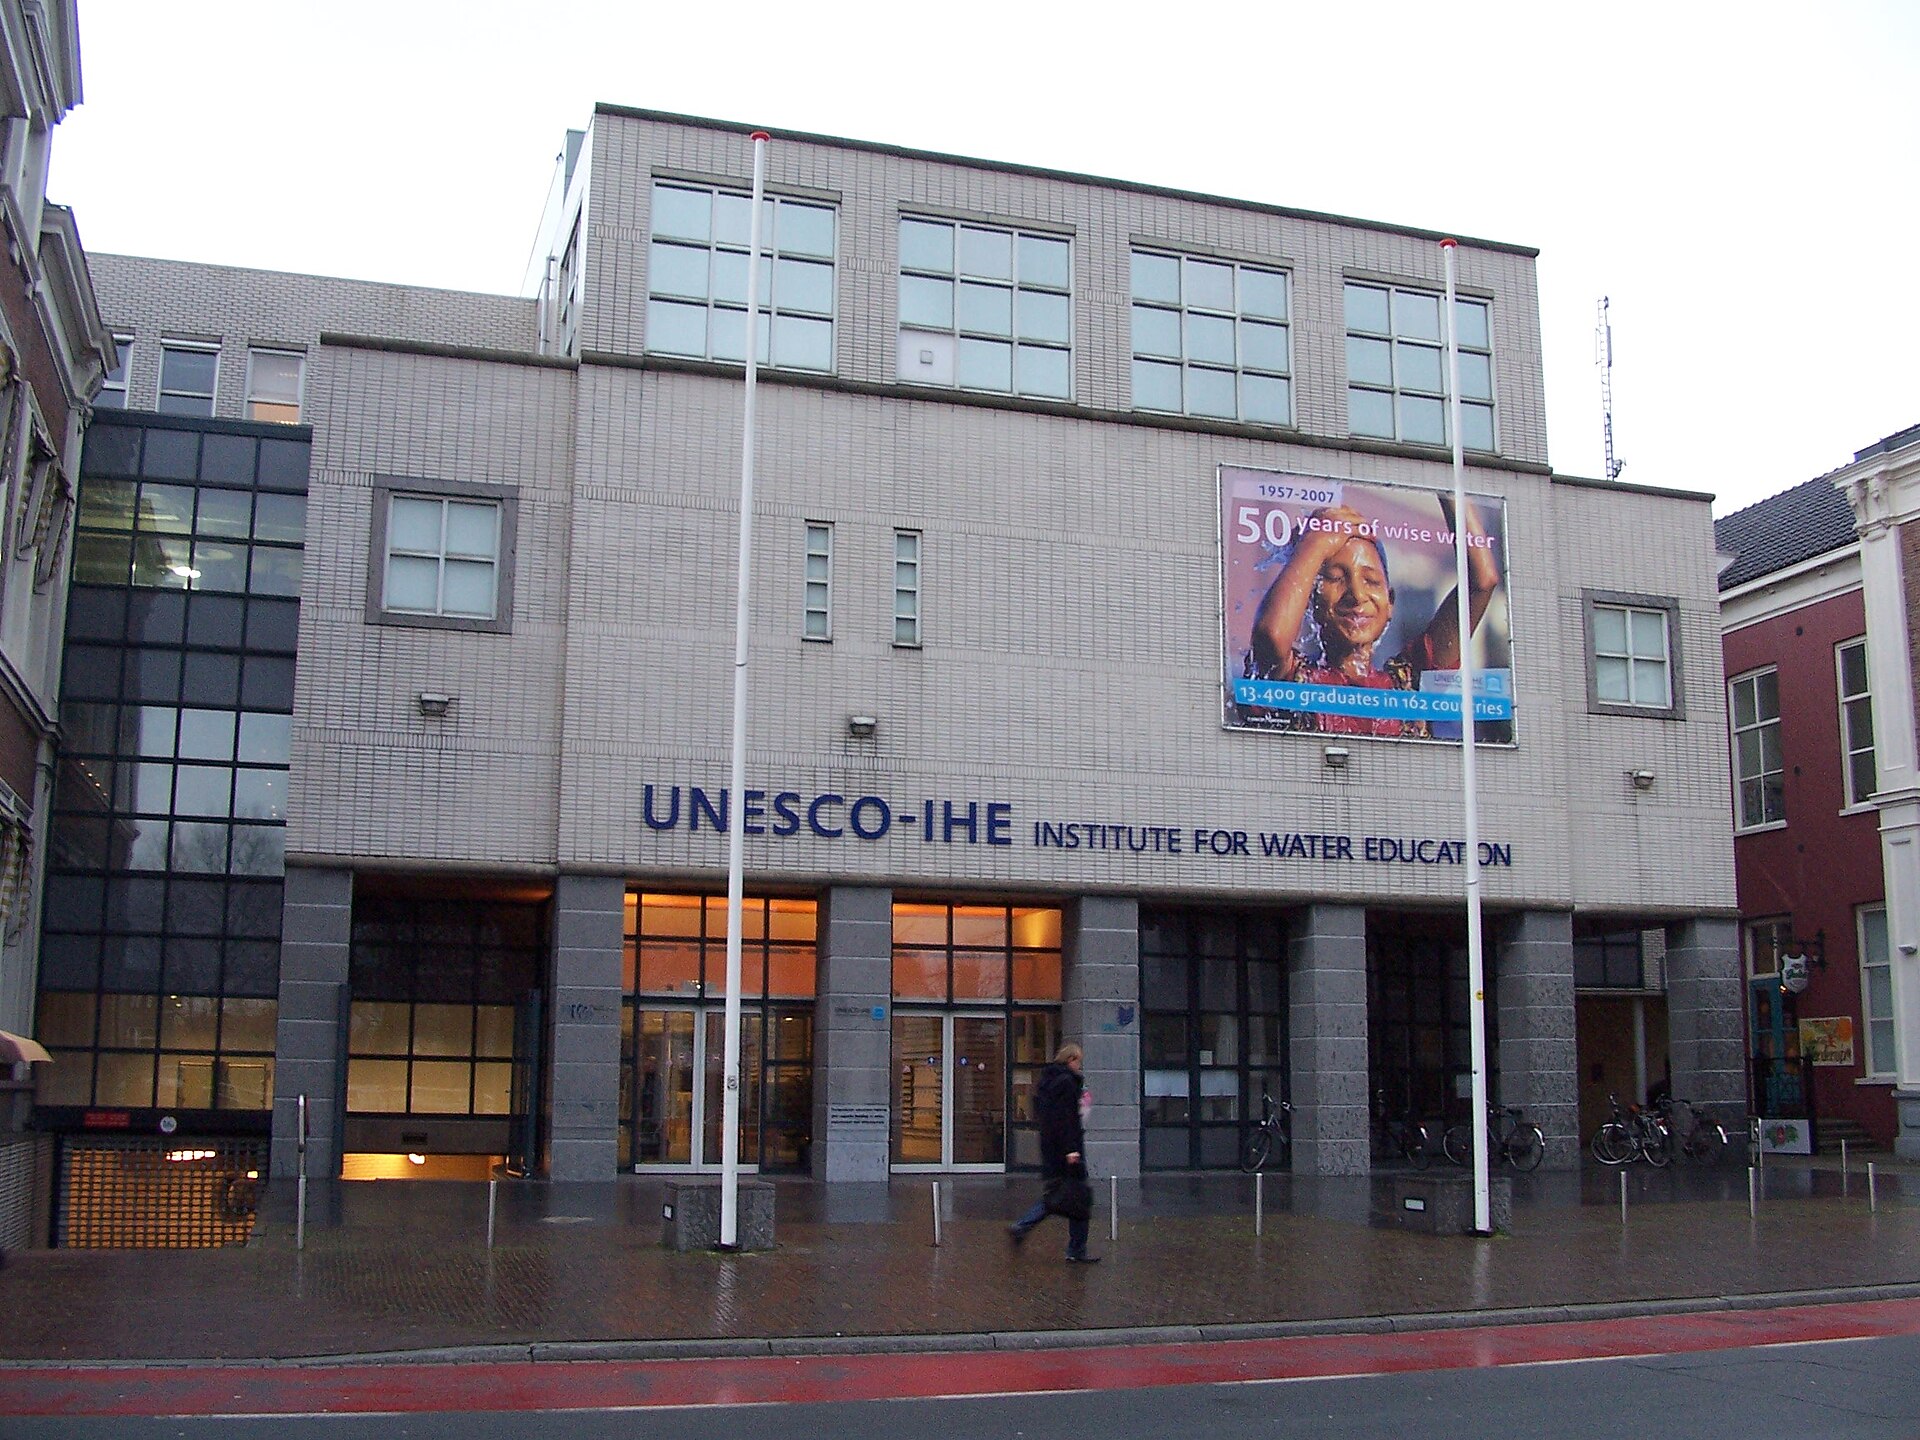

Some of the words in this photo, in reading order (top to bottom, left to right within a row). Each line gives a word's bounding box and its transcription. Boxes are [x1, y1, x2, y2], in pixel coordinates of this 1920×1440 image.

[1259, 485, 1334, 503] 1957-2007
[1237, 506, 1292, 547] 50
[1296, 515, 1353, 536] years
[1358, 518, 1379, 536] of
[1384, 522, 1431, 541] wise
[1436, 531, 1495, 549] wter
[1240, 686, 1295, 703] 13.400
[1300, 690, 1380, 707] graduates
[1383, 695, 1398, 708] in
[1402, 697, 1428, 710] 162
[1432, 699, 1504, 716] couries
[642, 784, 1013, 845] UNESCO-IHE
[1034, 821, 1182, 853] INSTITUTE
[1194, 829, 1251, 856] FOR
[1259, 832, 1355, 860] WATER
[1365, 836, 1512, 867] EDUCATON
